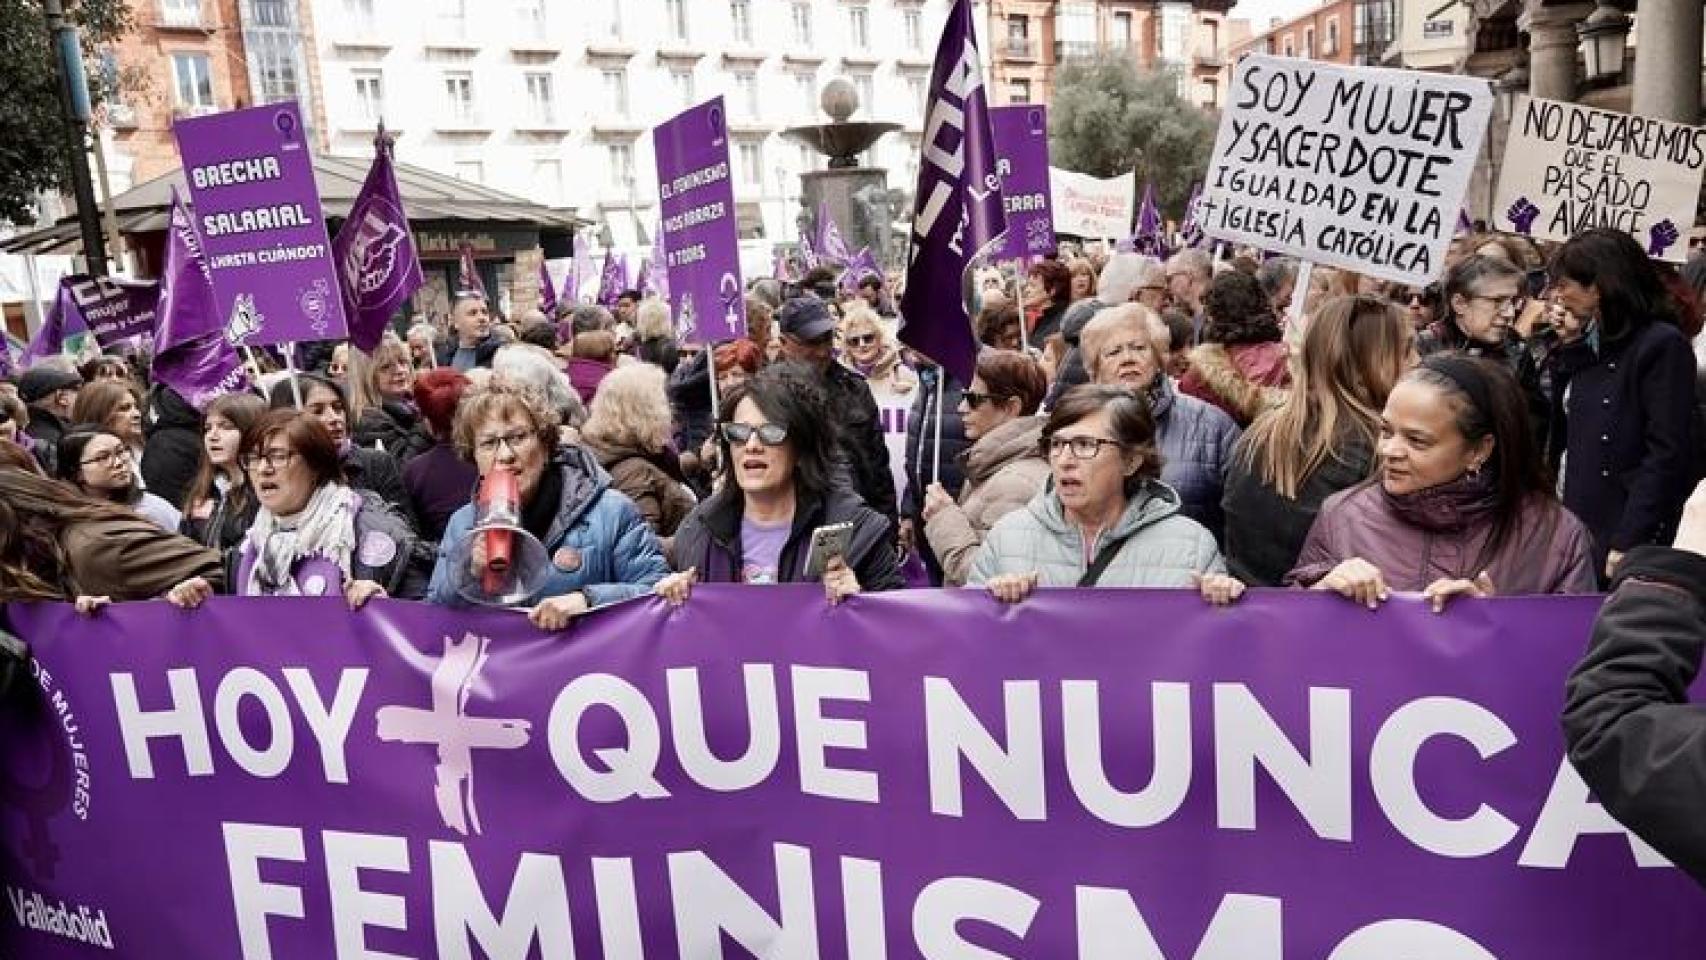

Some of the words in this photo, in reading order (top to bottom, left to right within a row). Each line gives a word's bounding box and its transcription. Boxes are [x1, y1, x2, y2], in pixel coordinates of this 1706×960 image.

[1237, 66, 1315, 116] SOY
[1322, 77, 1472, 149] MUJER
[1524, 100, 1563, 141] NO
[1567, 108, 1706, 169] DEJAREMOS
[192, 156, 281, 188] BRECHA
[1542, 165, 1651, 210] PASADO
[1564, 147, 1597, 172] QUE
[1603, 154, 1625, 176] EL
[204, 203, 313, 236] SALARIAL
[1002, 193, 1045, 212] ERRA
[1214, 166, 1357, 215] IGUALDAD
[1361, 192, 1399, 225] EN
[1404, 201, 1441, 239] LA
[1548, 200, 1645, 238] AVANCE
[258, 242, 325, 264] CUÁNDO?
[1220, 203, 1306, 247] IGLESIA
[1316, 224, 1430, 273] CATÓLICA
[51, 689, 90, 821] MUJERES
[110, 666, 369, 783] HOY
[547, 663, 881, 804] QUE
[925, 675, 1676, 869] NUNCA
[6, 884, 115, 949] Valladolid
[222, 820, 1502, 960] FEMINIS
